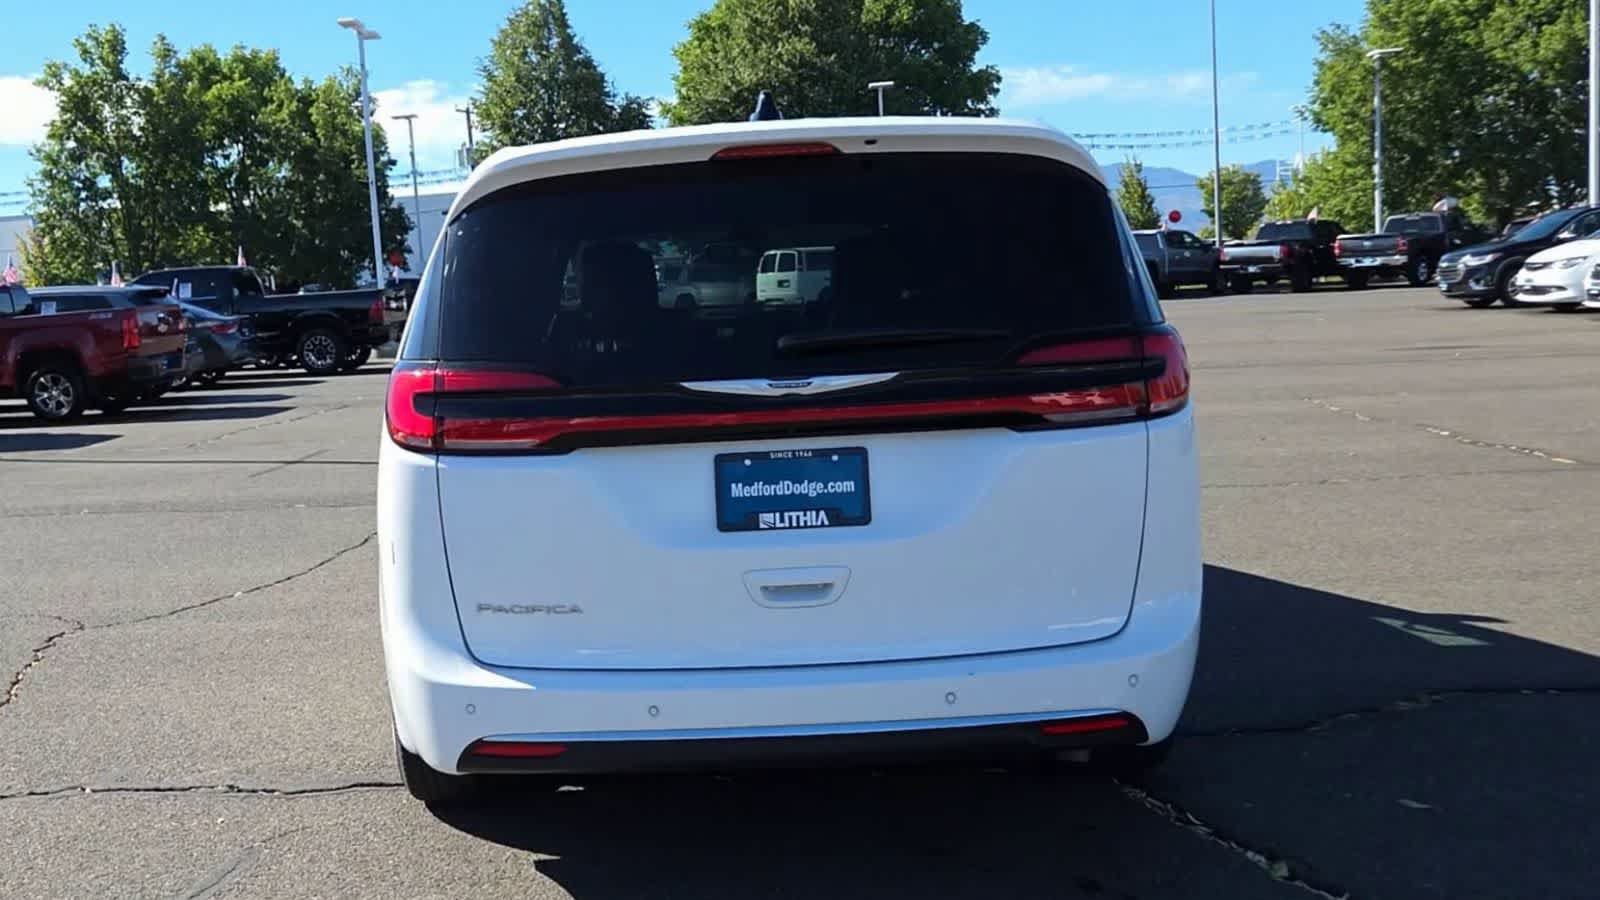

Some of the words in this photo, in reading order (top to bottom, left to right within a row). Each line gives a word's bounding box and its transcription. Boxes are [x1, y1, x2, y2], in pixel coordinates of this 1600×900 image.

[770, 451, 793, 459] SINCE
[731, 480, 855, 497] MedfordDodge.com
[775, 510, 829, 527] LITHIA
[477, 603, 584, 614] PACIFICA
